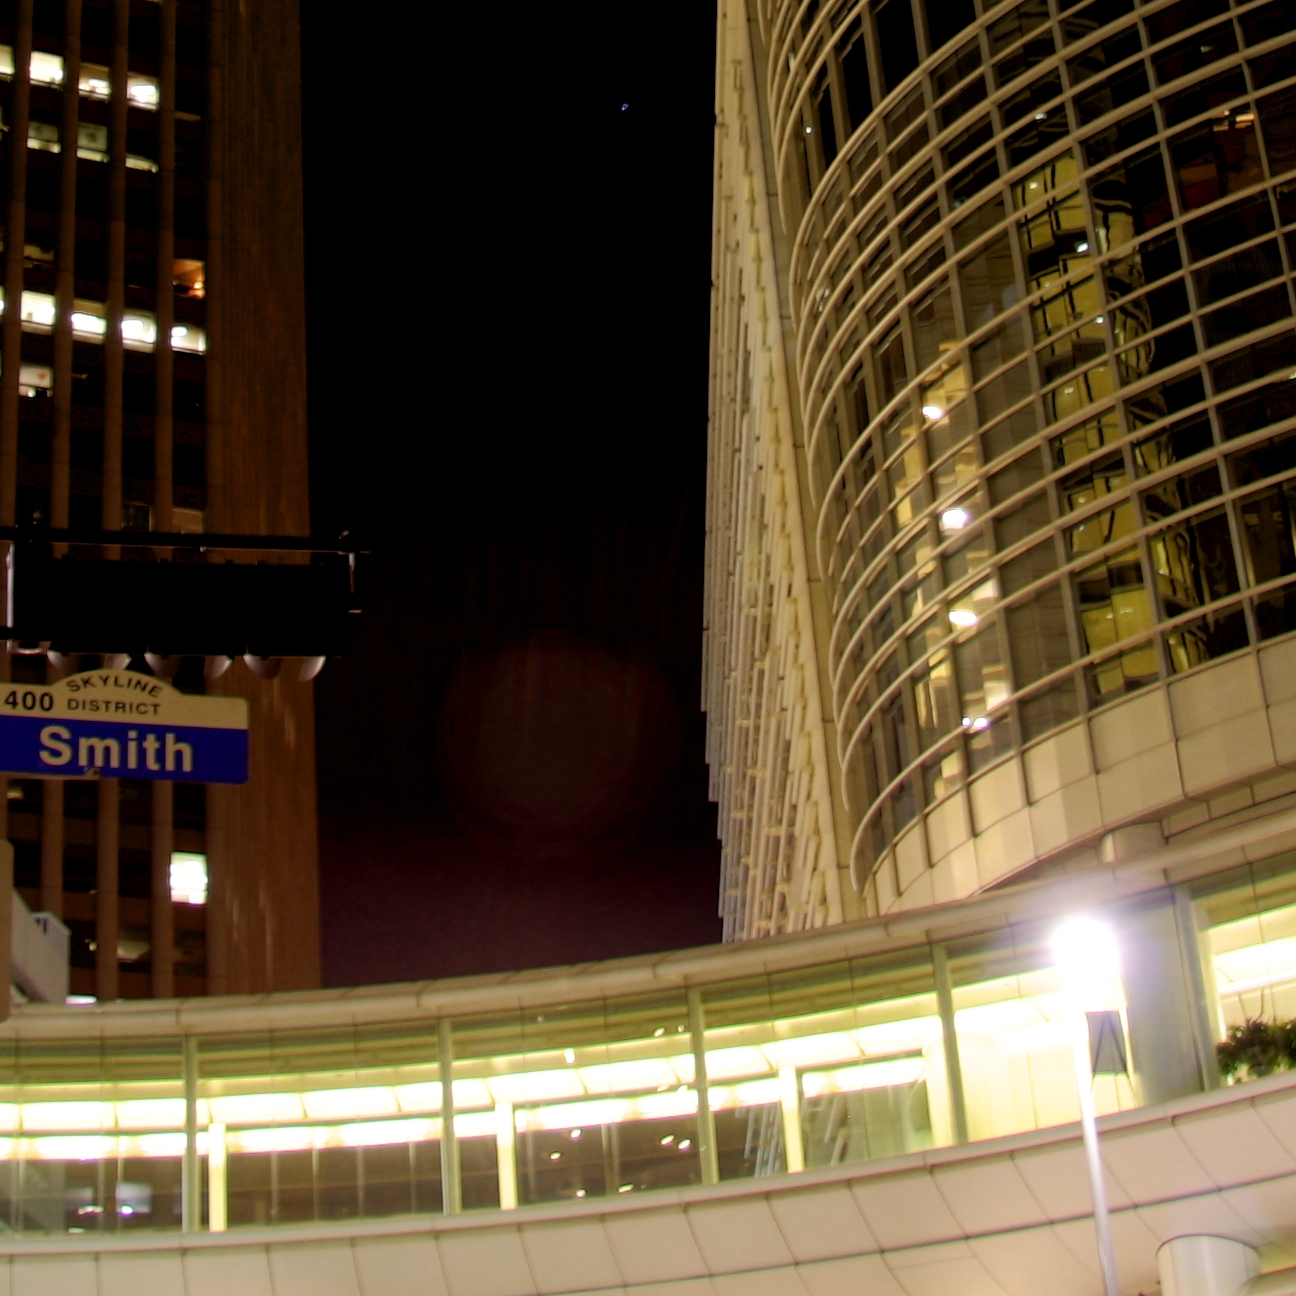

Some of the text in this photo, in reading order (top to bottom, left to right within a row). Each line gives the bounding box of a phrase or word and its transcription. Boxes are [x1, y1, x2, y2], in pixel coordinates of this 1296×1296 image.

[66, 675, 163, 698] SKYLINE
[67, 698, 162, 716] DISTRICT
[39, 725, 194, 773] Smith
